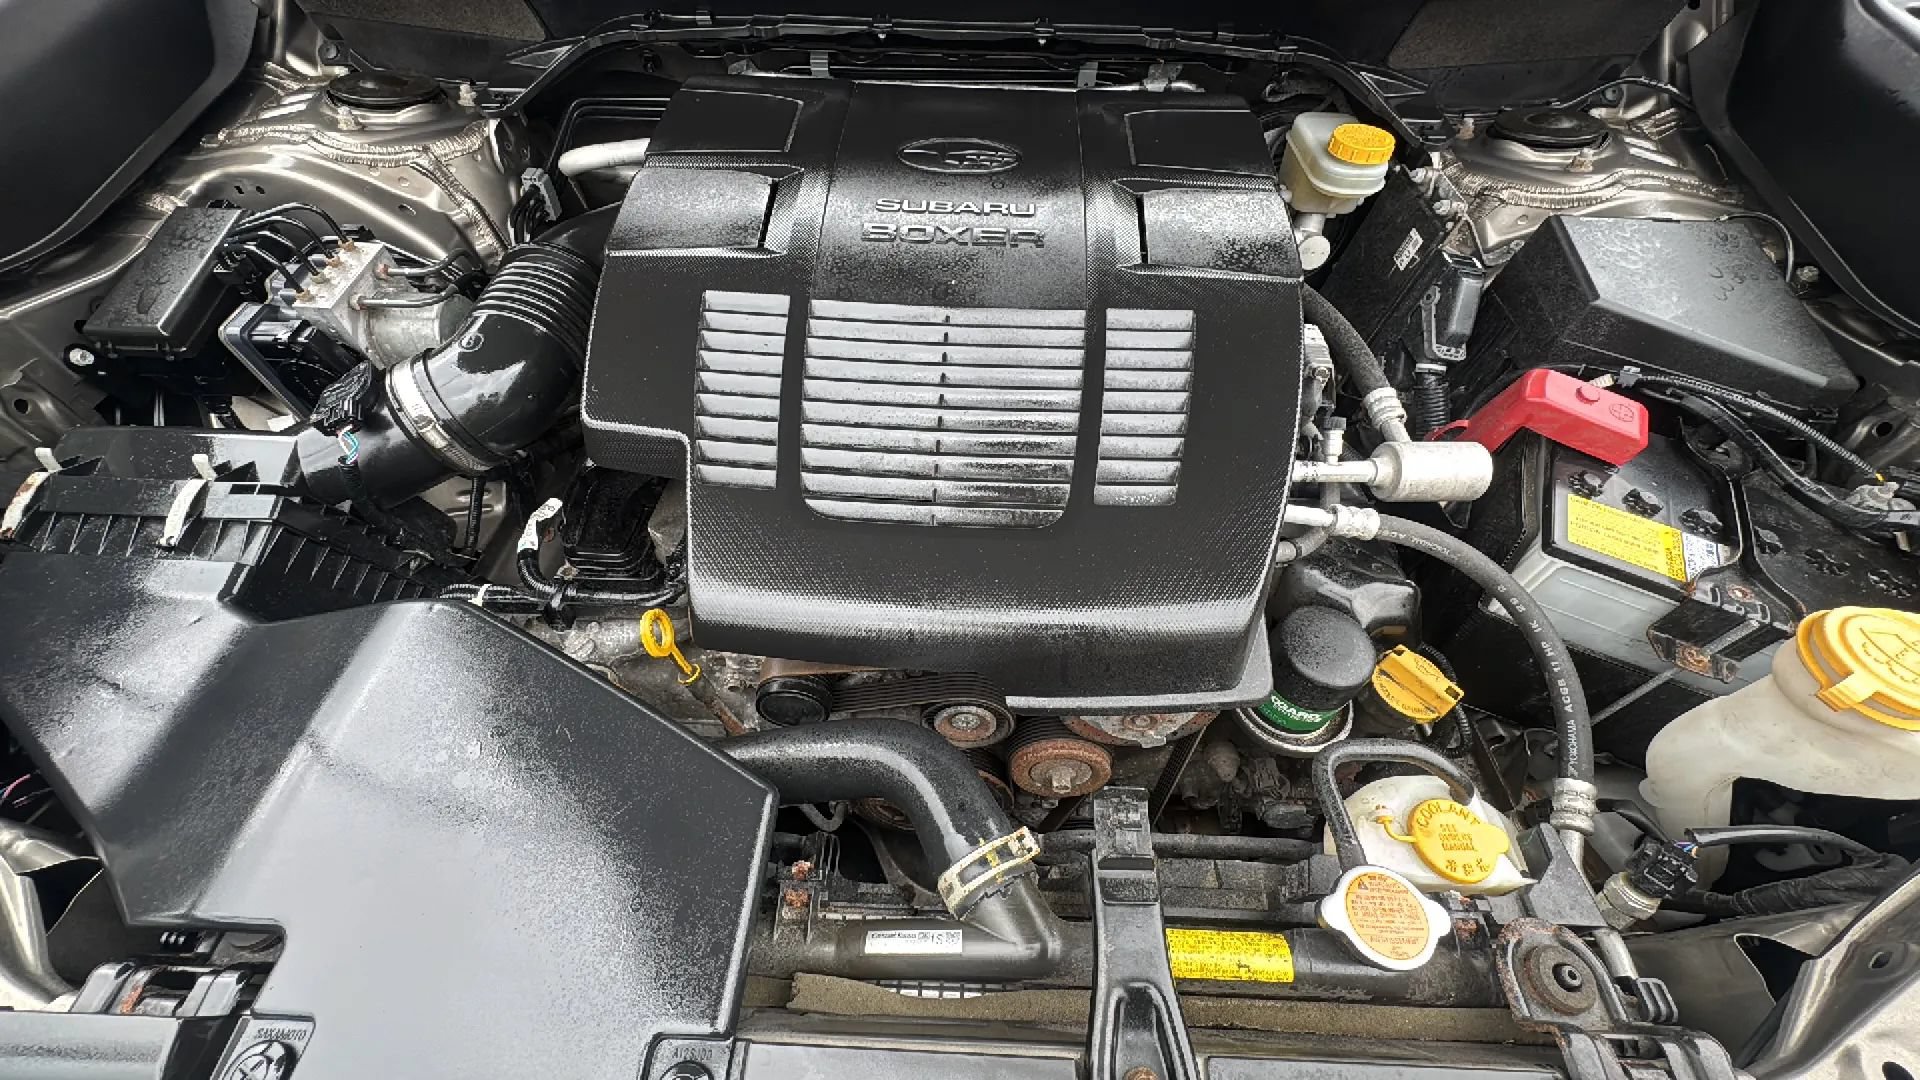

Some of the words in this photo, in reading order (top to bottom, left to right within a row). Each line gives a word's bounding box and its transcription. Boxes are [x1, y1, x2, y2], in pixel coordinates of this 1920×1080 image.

[875, 198, 1036, 216] SUBARU
[861, 222, 1046, 249] BOXER
[1566, 719, 1578, 764] YOKOHAMA
[1416, 801, 1481, 830] COOLANT
[255, 1027, 307, 1041] SAKAMOTO
